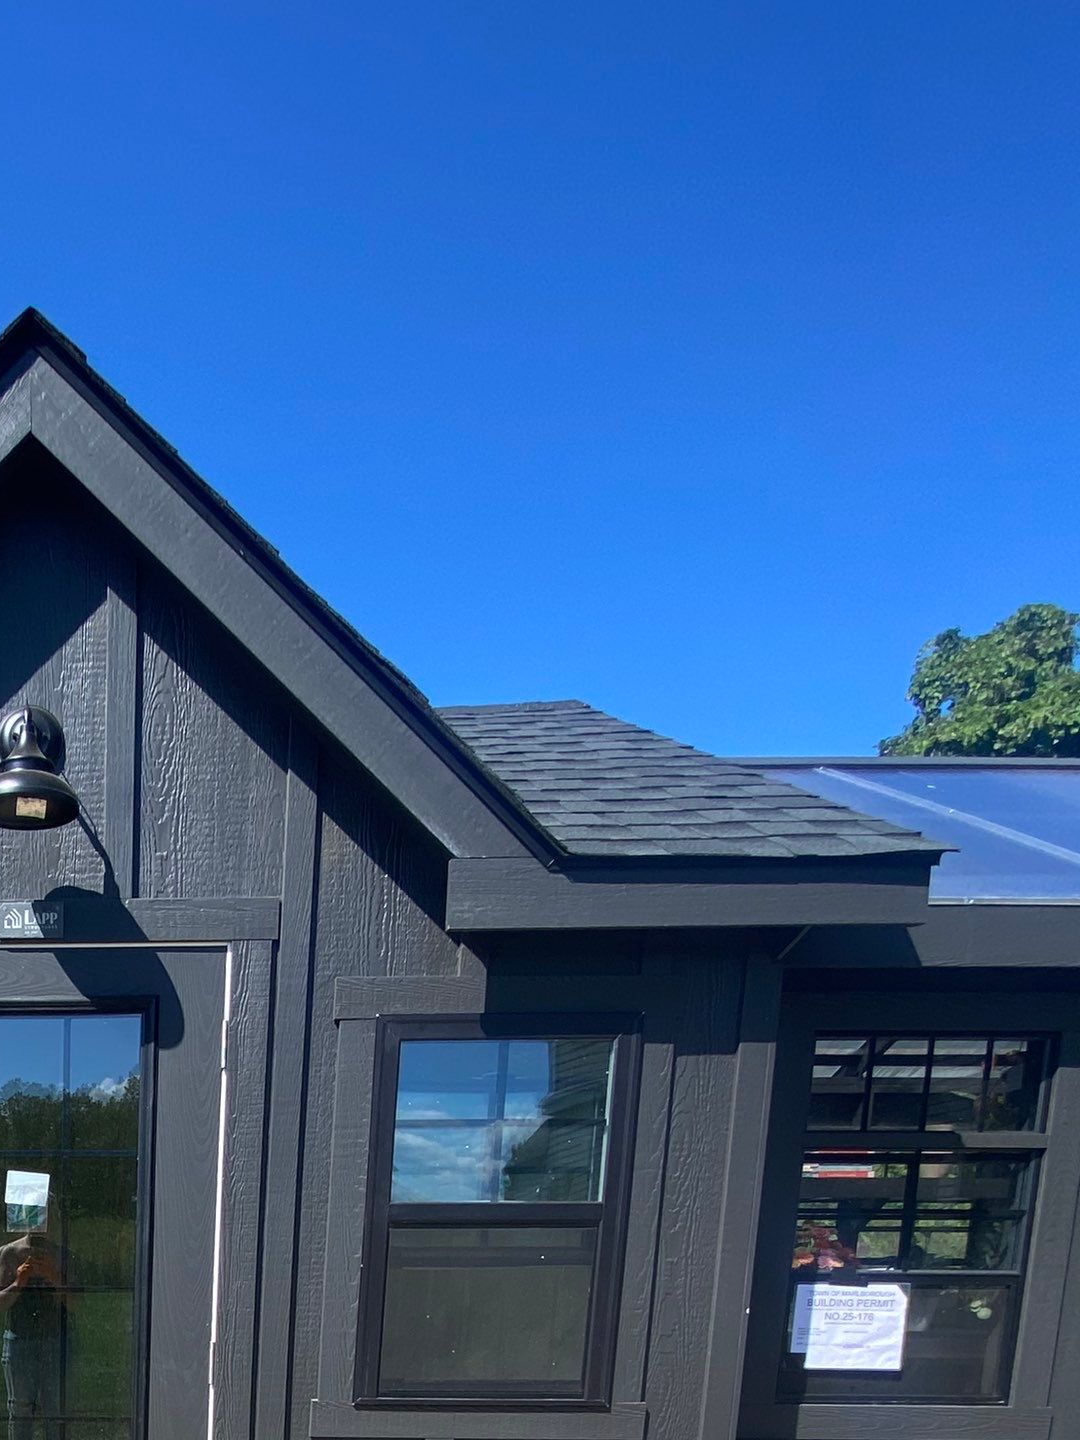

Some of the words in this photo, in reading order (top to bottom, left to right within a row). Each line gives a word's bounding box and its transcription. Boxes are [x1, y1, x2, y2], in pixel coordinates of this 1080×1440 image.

[24, 909, 58, 925] LAPP
[807, 1298, 854, 1307] BUILDING
[856, 1299, 896, 1308] PERMIT
